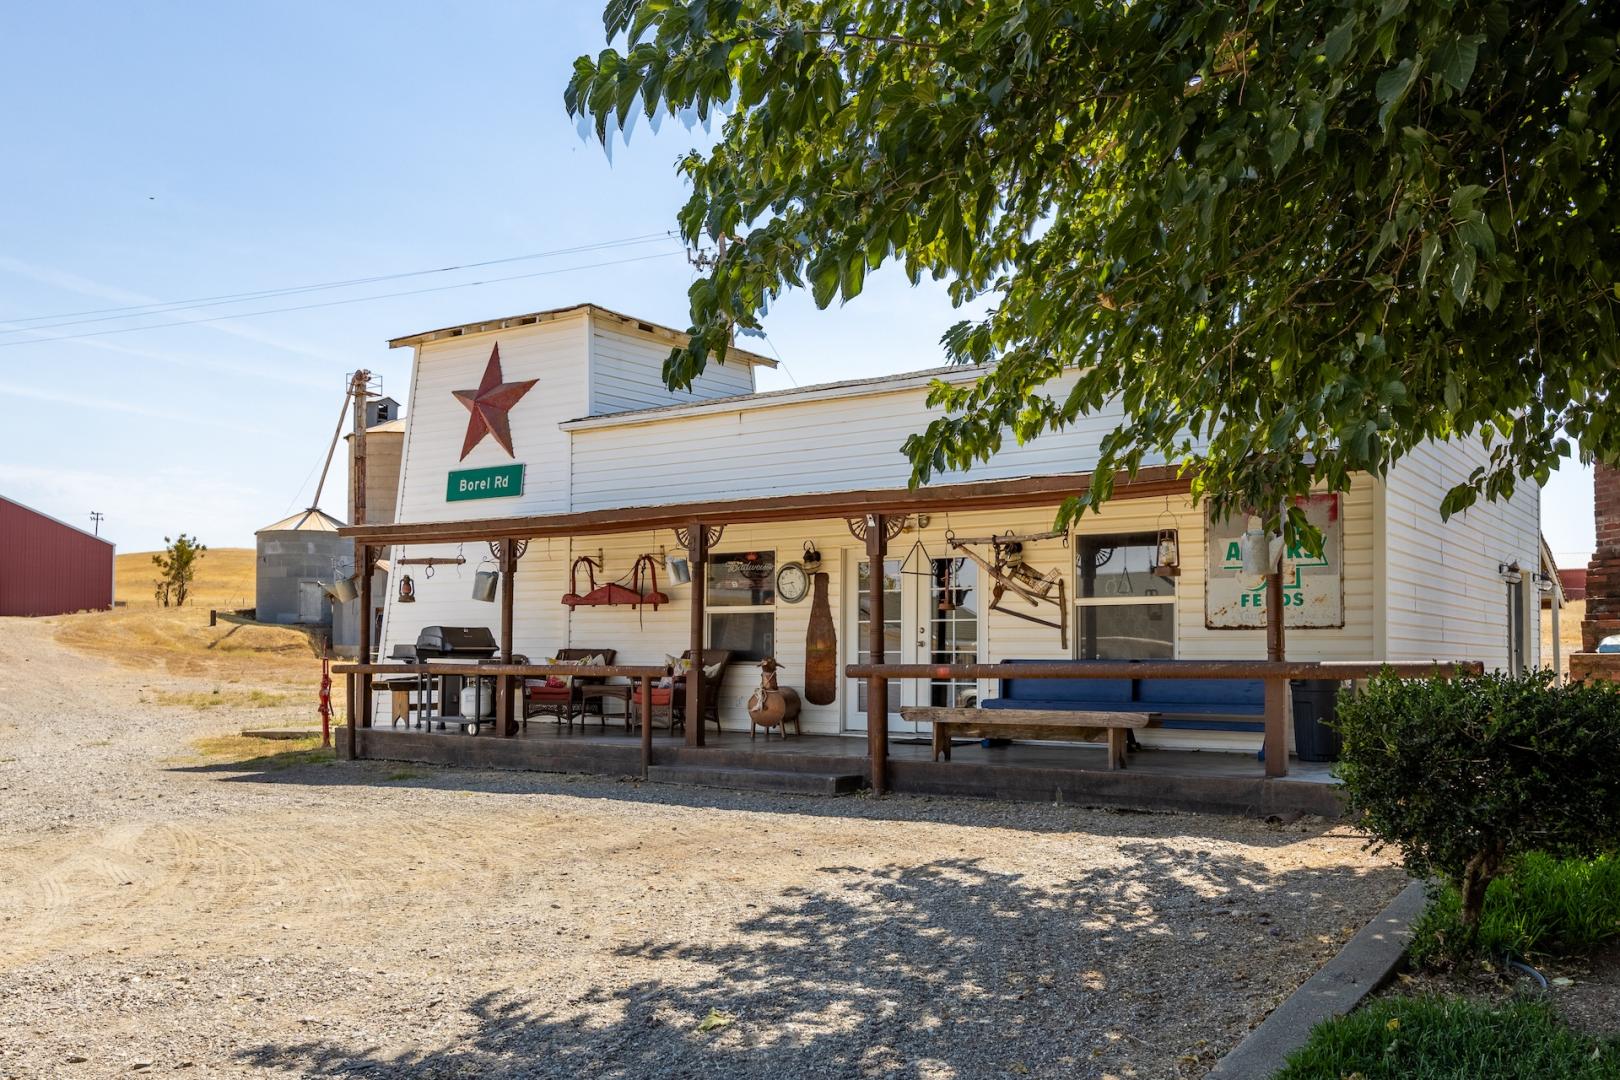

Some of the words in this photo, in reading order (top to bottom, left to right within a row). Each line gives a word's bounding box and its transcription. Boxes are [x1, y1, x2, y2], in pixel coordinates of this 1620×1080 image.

[459, 477, 490, 491] Borel
[494, 475, 509, 488] Rd
[1240, 592, 1304, 608] FEDS
